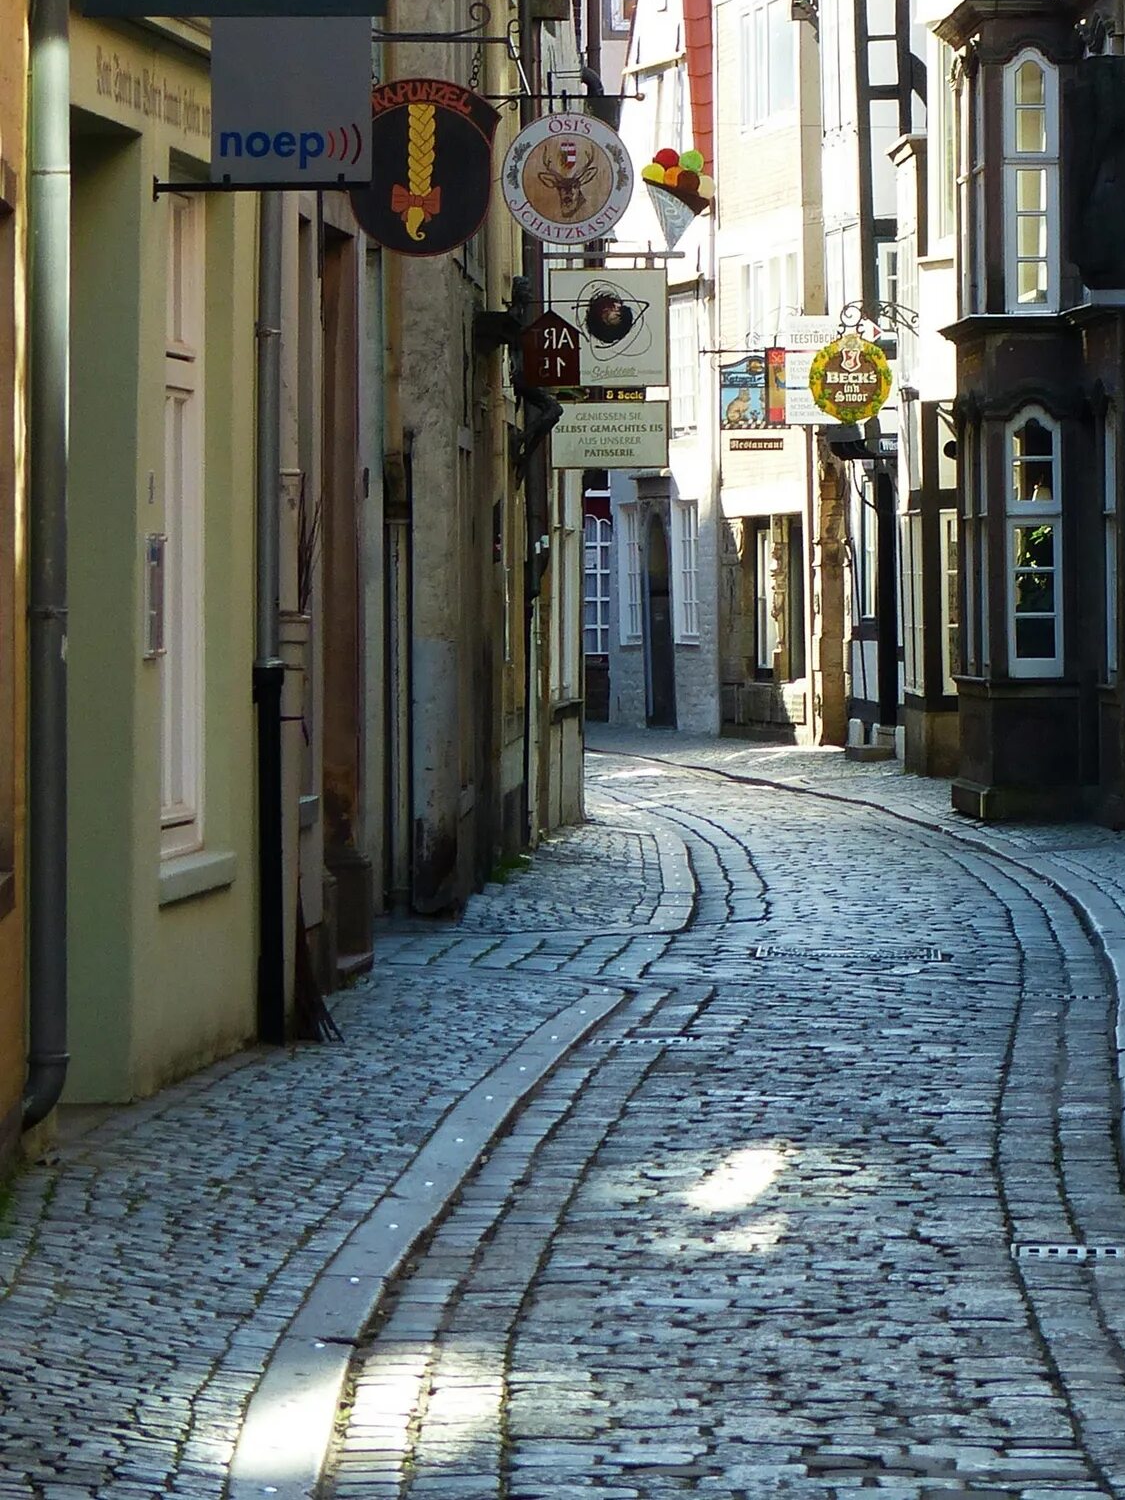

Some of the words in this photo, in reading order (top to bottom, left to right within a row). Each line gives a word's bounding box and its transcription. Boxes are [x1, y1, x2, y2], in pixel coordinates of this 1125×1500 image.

[371, 81, 472, 114] RAPUNZEL
[219, 130, 325, 169] noep
[575, 412, 627, 421] GENIESSEN
[629, 412, 643, 421] SIE
[554, 424, 587, 433] SELBST
[590, 424, 647, 433] GEMACHTES
[649, 424, 664, 433] EIS
[578, 436, 598, 445] AUS
[600, 436, 642, 445] UNSERER
[730, 439, 784, 450] Restaurant
[584, 447, 635, 458] PATISSERIE
